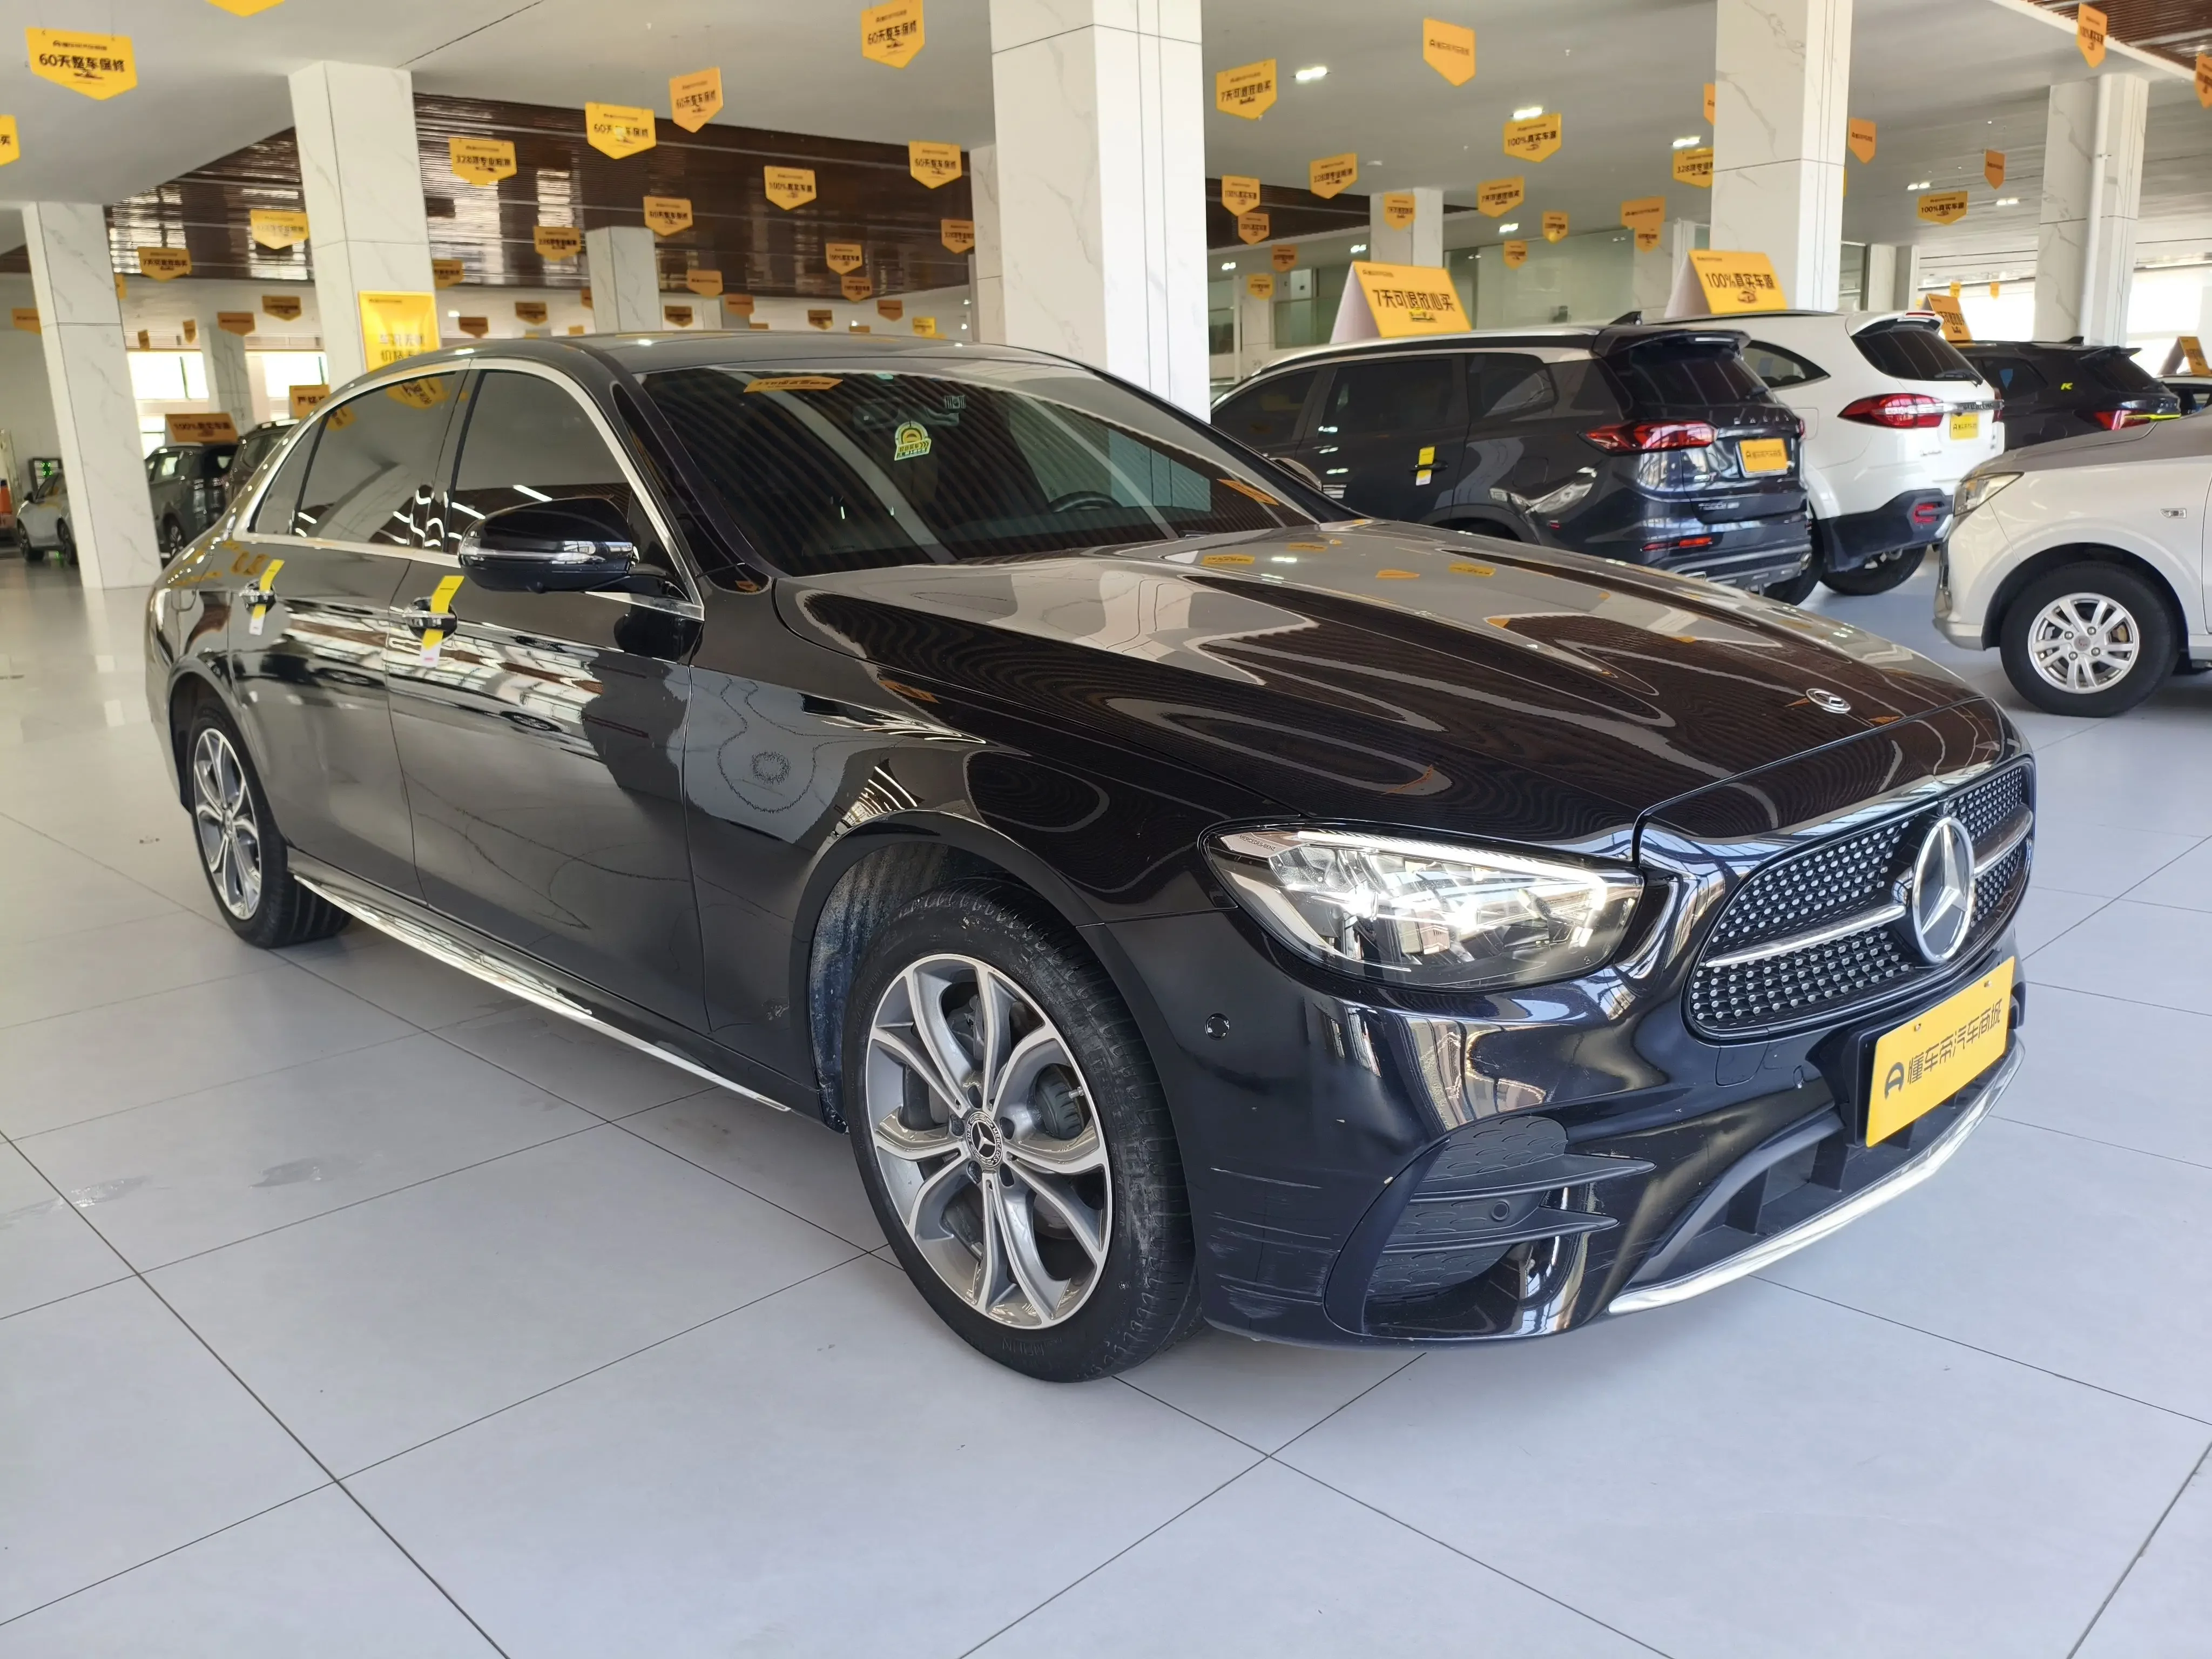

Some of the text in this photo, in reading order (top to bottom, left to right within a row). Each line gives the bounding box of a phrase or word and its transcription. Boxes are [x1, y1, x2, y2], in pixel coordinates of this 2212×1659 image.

[39, 53, 125, 72] 60天整车保修
[1705, 273, 1775, 289] 100%真实车源
[1372, 289, 1455, 312] 7天可退放心买
[1907, 998, 2002, 1084] 懂车帝汽车商城
[992, 1127, 1002, 1163] MERCEDES
